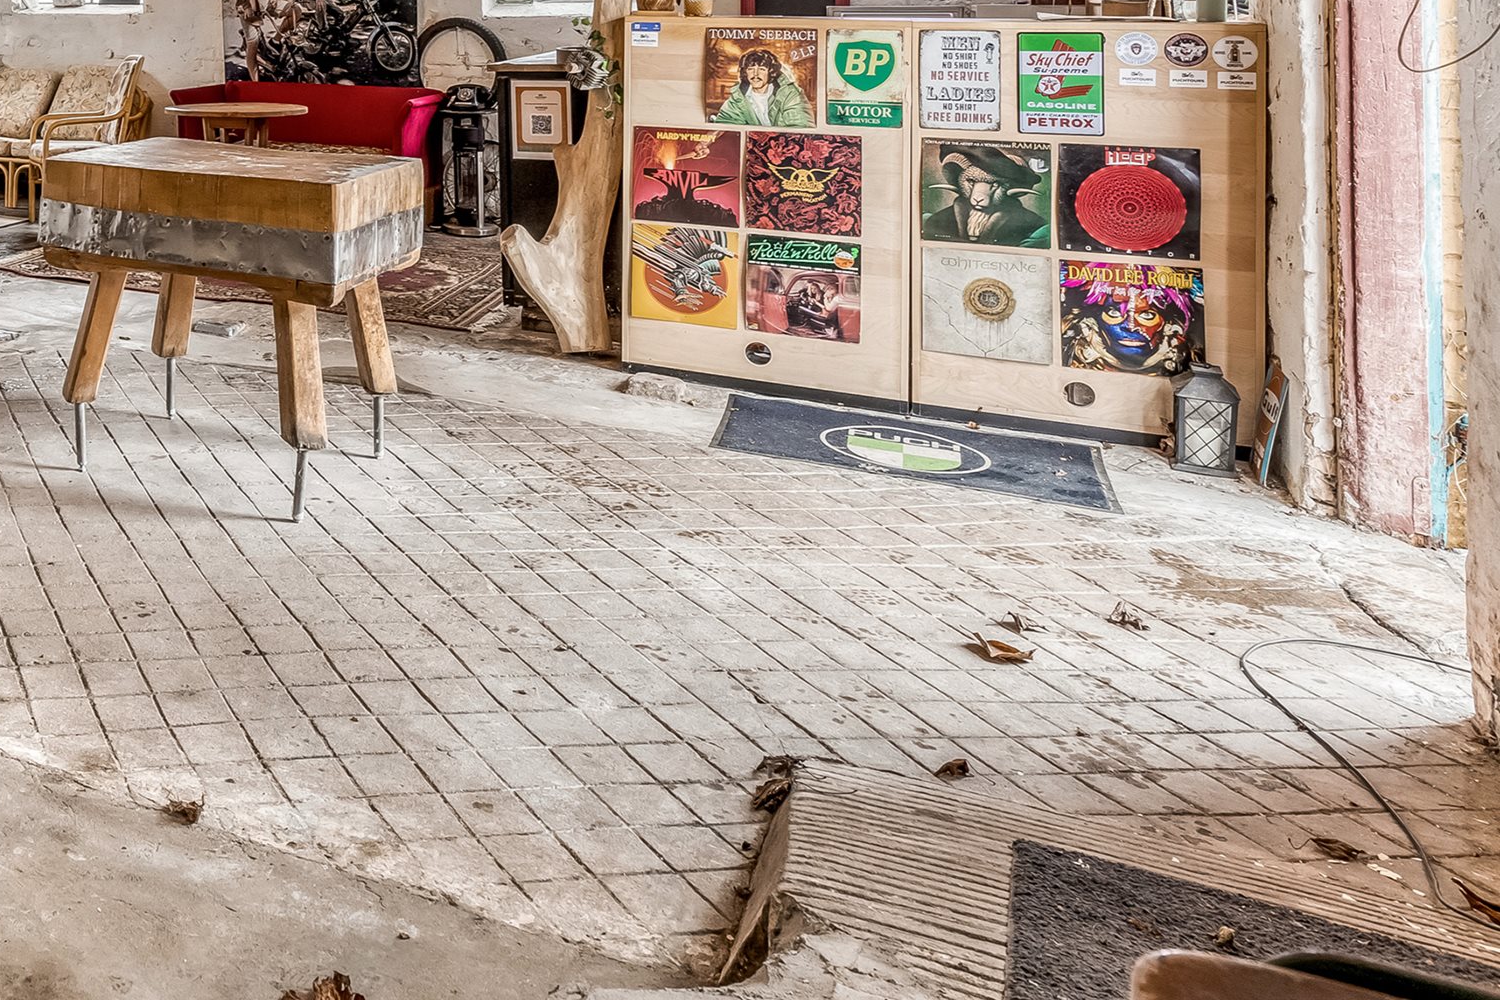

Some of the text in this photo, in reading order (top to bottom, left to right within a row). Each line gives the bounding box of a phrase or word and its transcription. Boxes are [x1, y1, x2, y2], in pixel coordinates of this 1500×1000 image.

[708, 28, 816, 42] TOMMY SEEBACH
[941, 35, 981, 51] MEN
[790, 45, 816, 62] 2 LP
[942, 52, 977, 60] NO SHIRT
[1026, 52, 1095, 68] Sky Chief
[843, 48, 890, 76] BP
[942, 61, 978, 69] NO SHOES
[930, 71, 990, 82] NO SERVICE
[926, 86, 996, 102] LADIES
[835, 104, 893, 118] MOTOR
[942, 103, 977, 111] NO SHIRT
[1026, 101, 1097, 110] GASOLINE
[927, 111, 993, 124] FREE DRINKS
[1028, 117, 1094, 128] PETROX
[1011, 142, 1033, 150] RAM
[1033, 143, 1051, 151] JAM
[652, 168, 709, 200] ANVIL
[1067, 265, 1194, 289] DAVID LEE ROTH
[847, 428, 961, 452] PUCH
